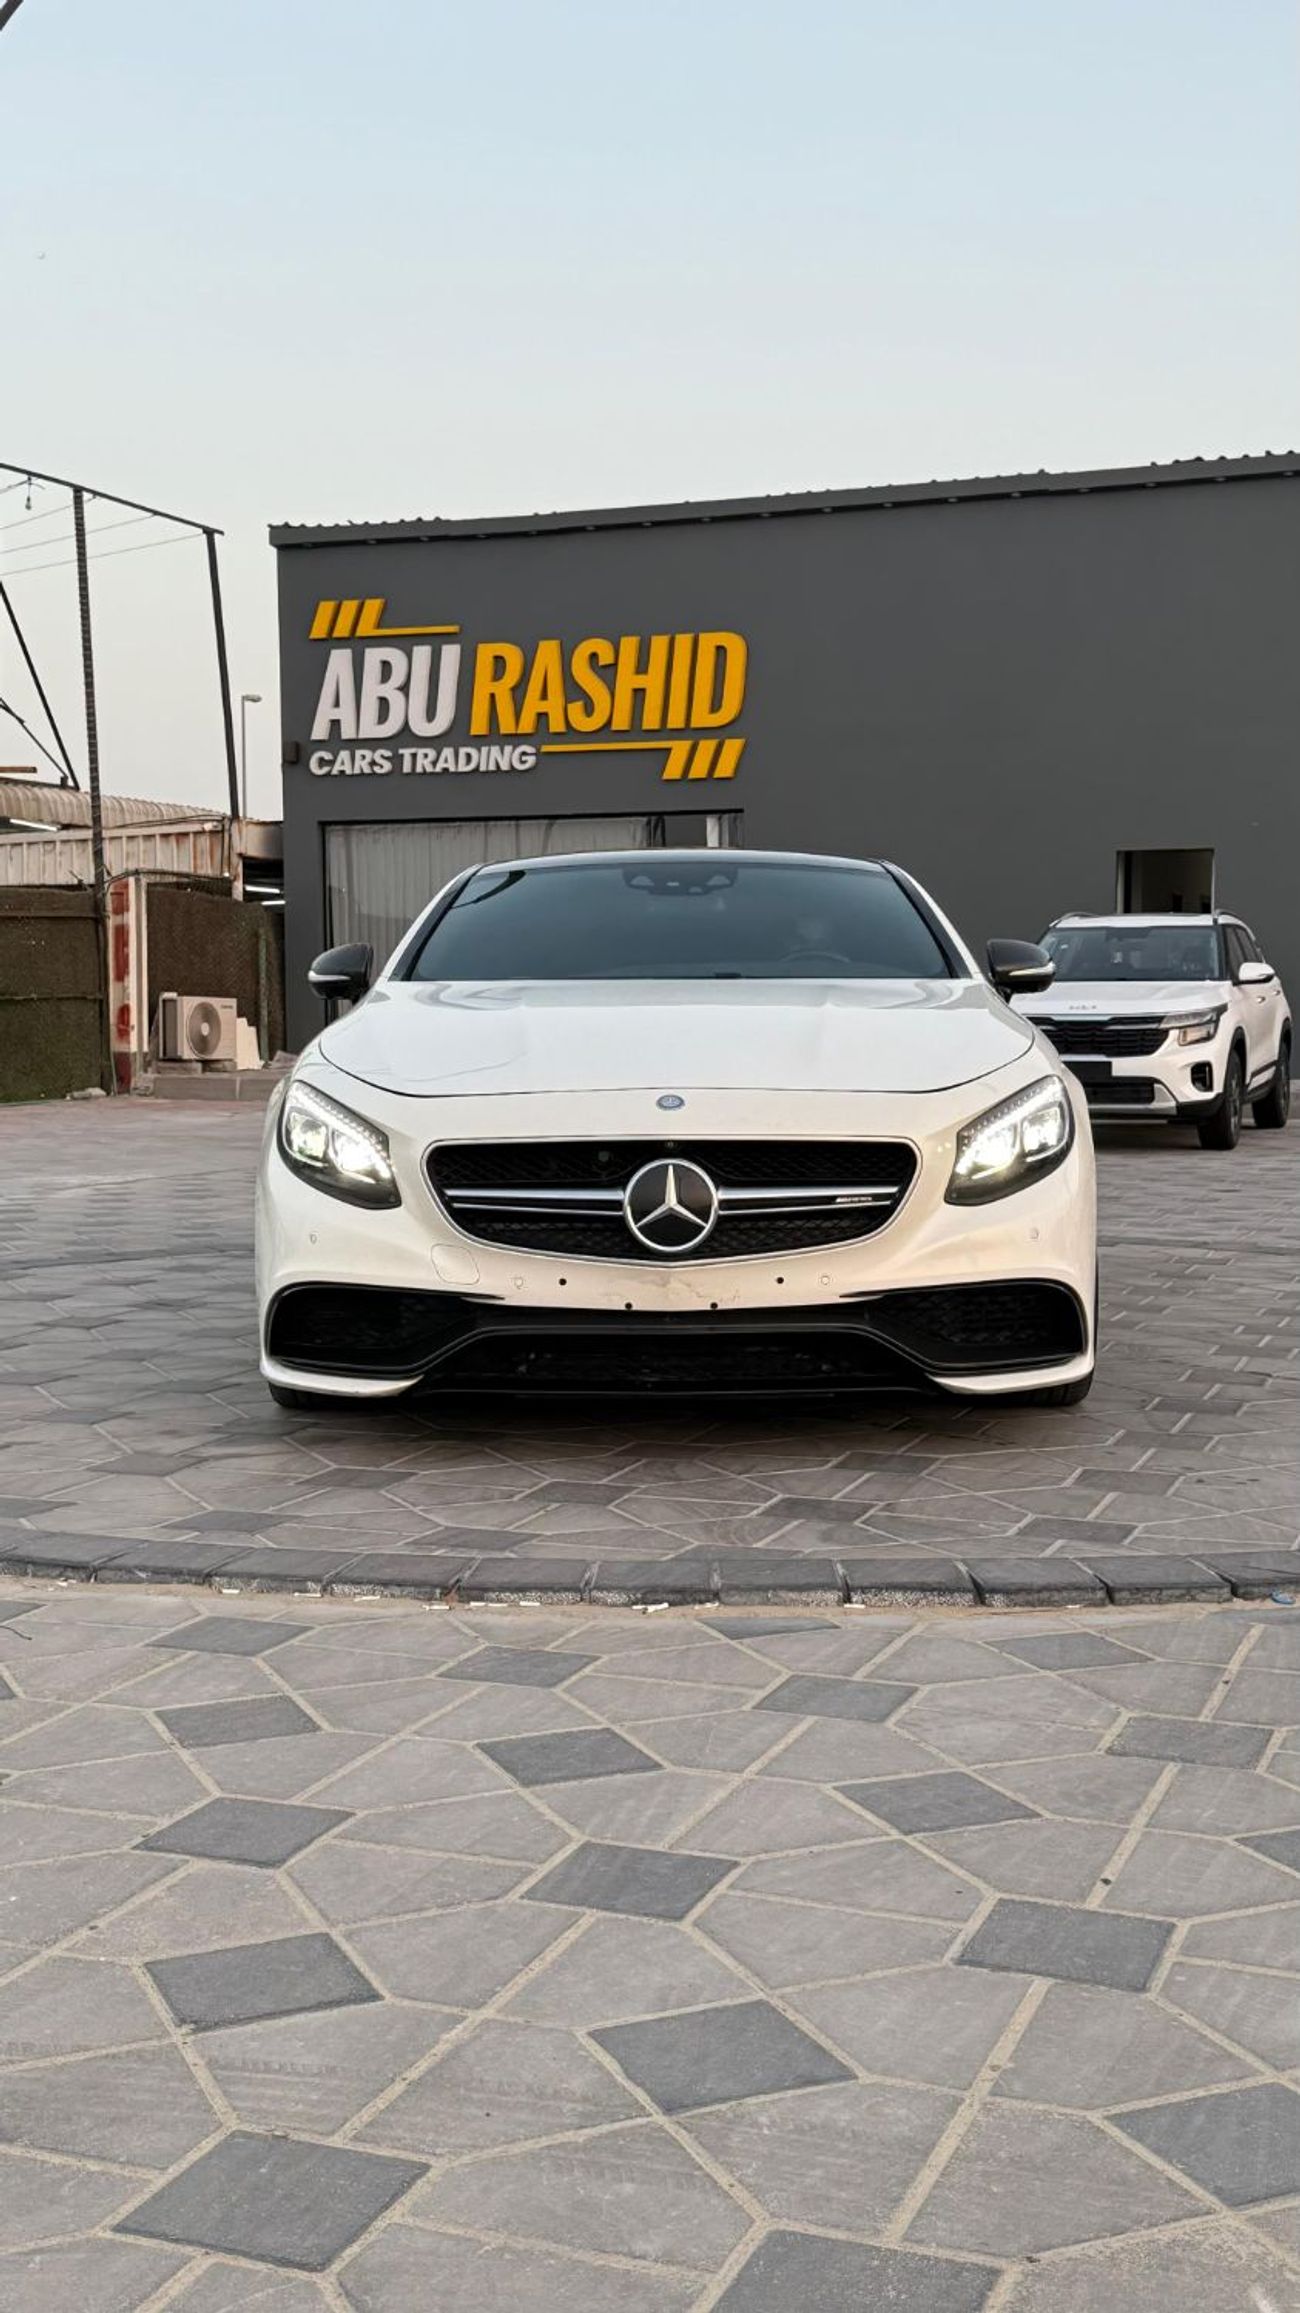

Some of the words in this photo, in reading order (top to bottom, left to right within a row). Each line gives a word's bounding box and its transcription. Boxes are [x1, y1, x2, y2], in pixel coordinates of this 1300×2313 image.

[310, 644, 461, 741] ABU
[469, 631, 748, 736] RASHID
[309, 748, 393, 776] CARS
[398, 744, 537, 773] TRADING
